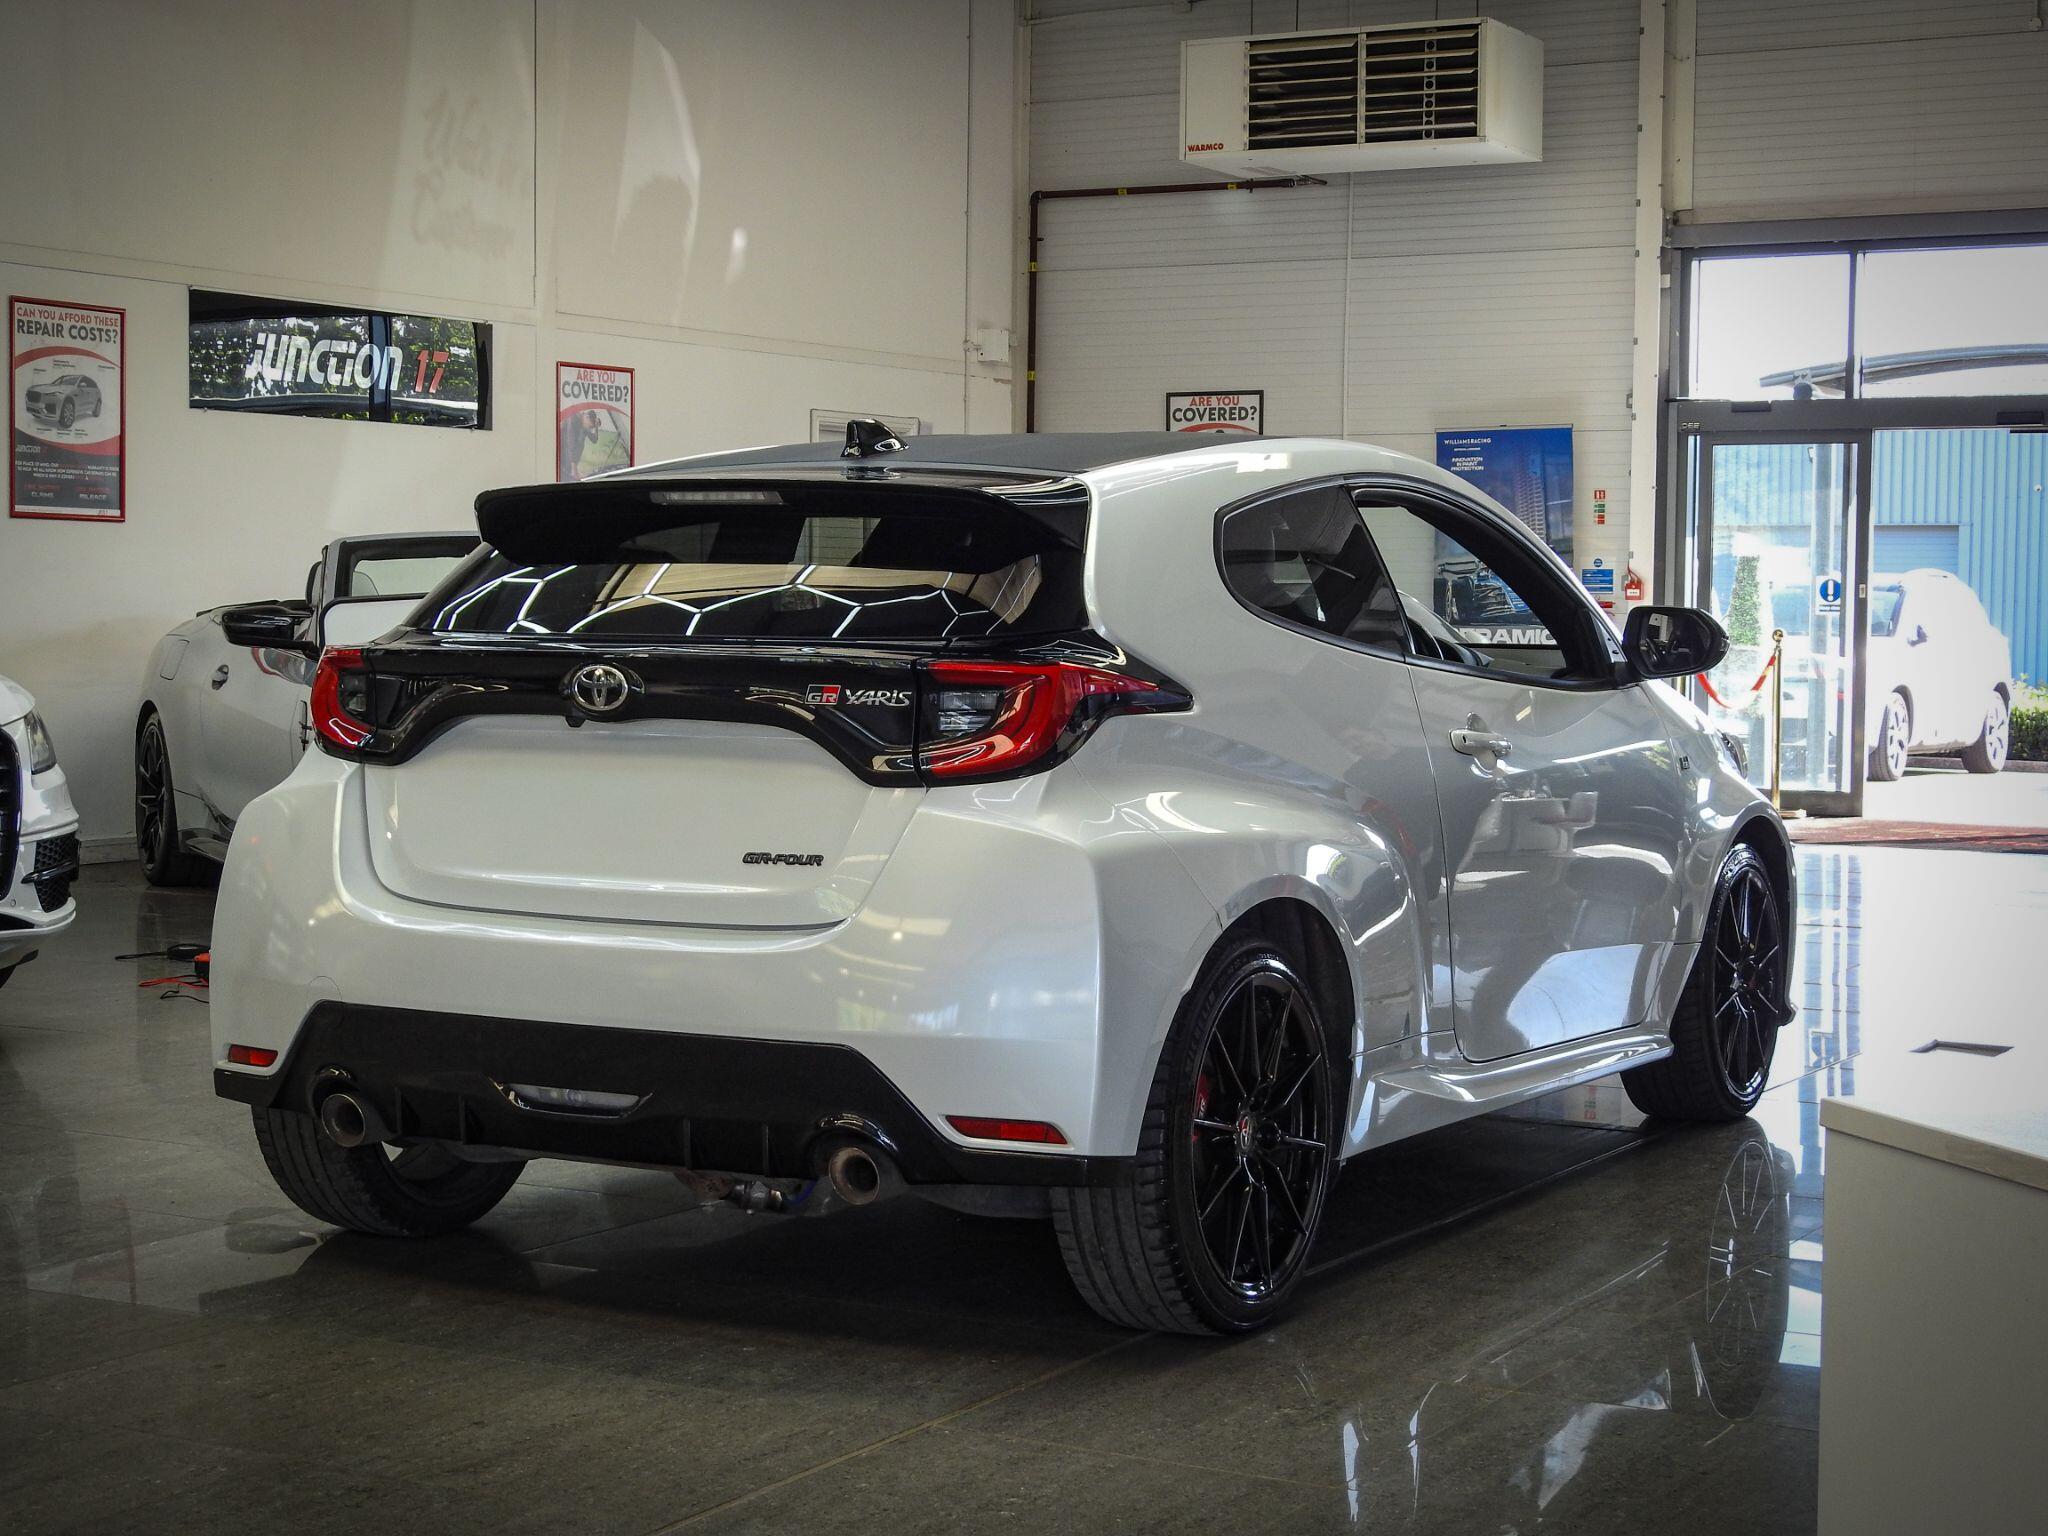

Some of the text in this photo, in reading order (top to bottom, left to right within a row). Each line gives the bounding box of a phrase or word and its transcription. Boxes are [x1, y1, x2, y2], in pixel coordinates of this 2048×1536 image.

[1187, 143, 1224, 152] WARMCO
[16, 306, 119, 328] CAN YOU AFFORD THESE
[16, 318, 119, 344] REPAIR COSTS?
[415, 349, 450, 394] 17
[576, 370, 616, 384] ARE YOU
[562, 380, 629, 403] COVERED?
[1189, 396, 1240, 407] ARE YOU
[1172, 406, 1258, 422] COVERED?
[1460, 627, 1558, 645] RAMIC
[845, 689, 912, 707] YARIS
[742, 852, 825, 866] GR-FOUR
